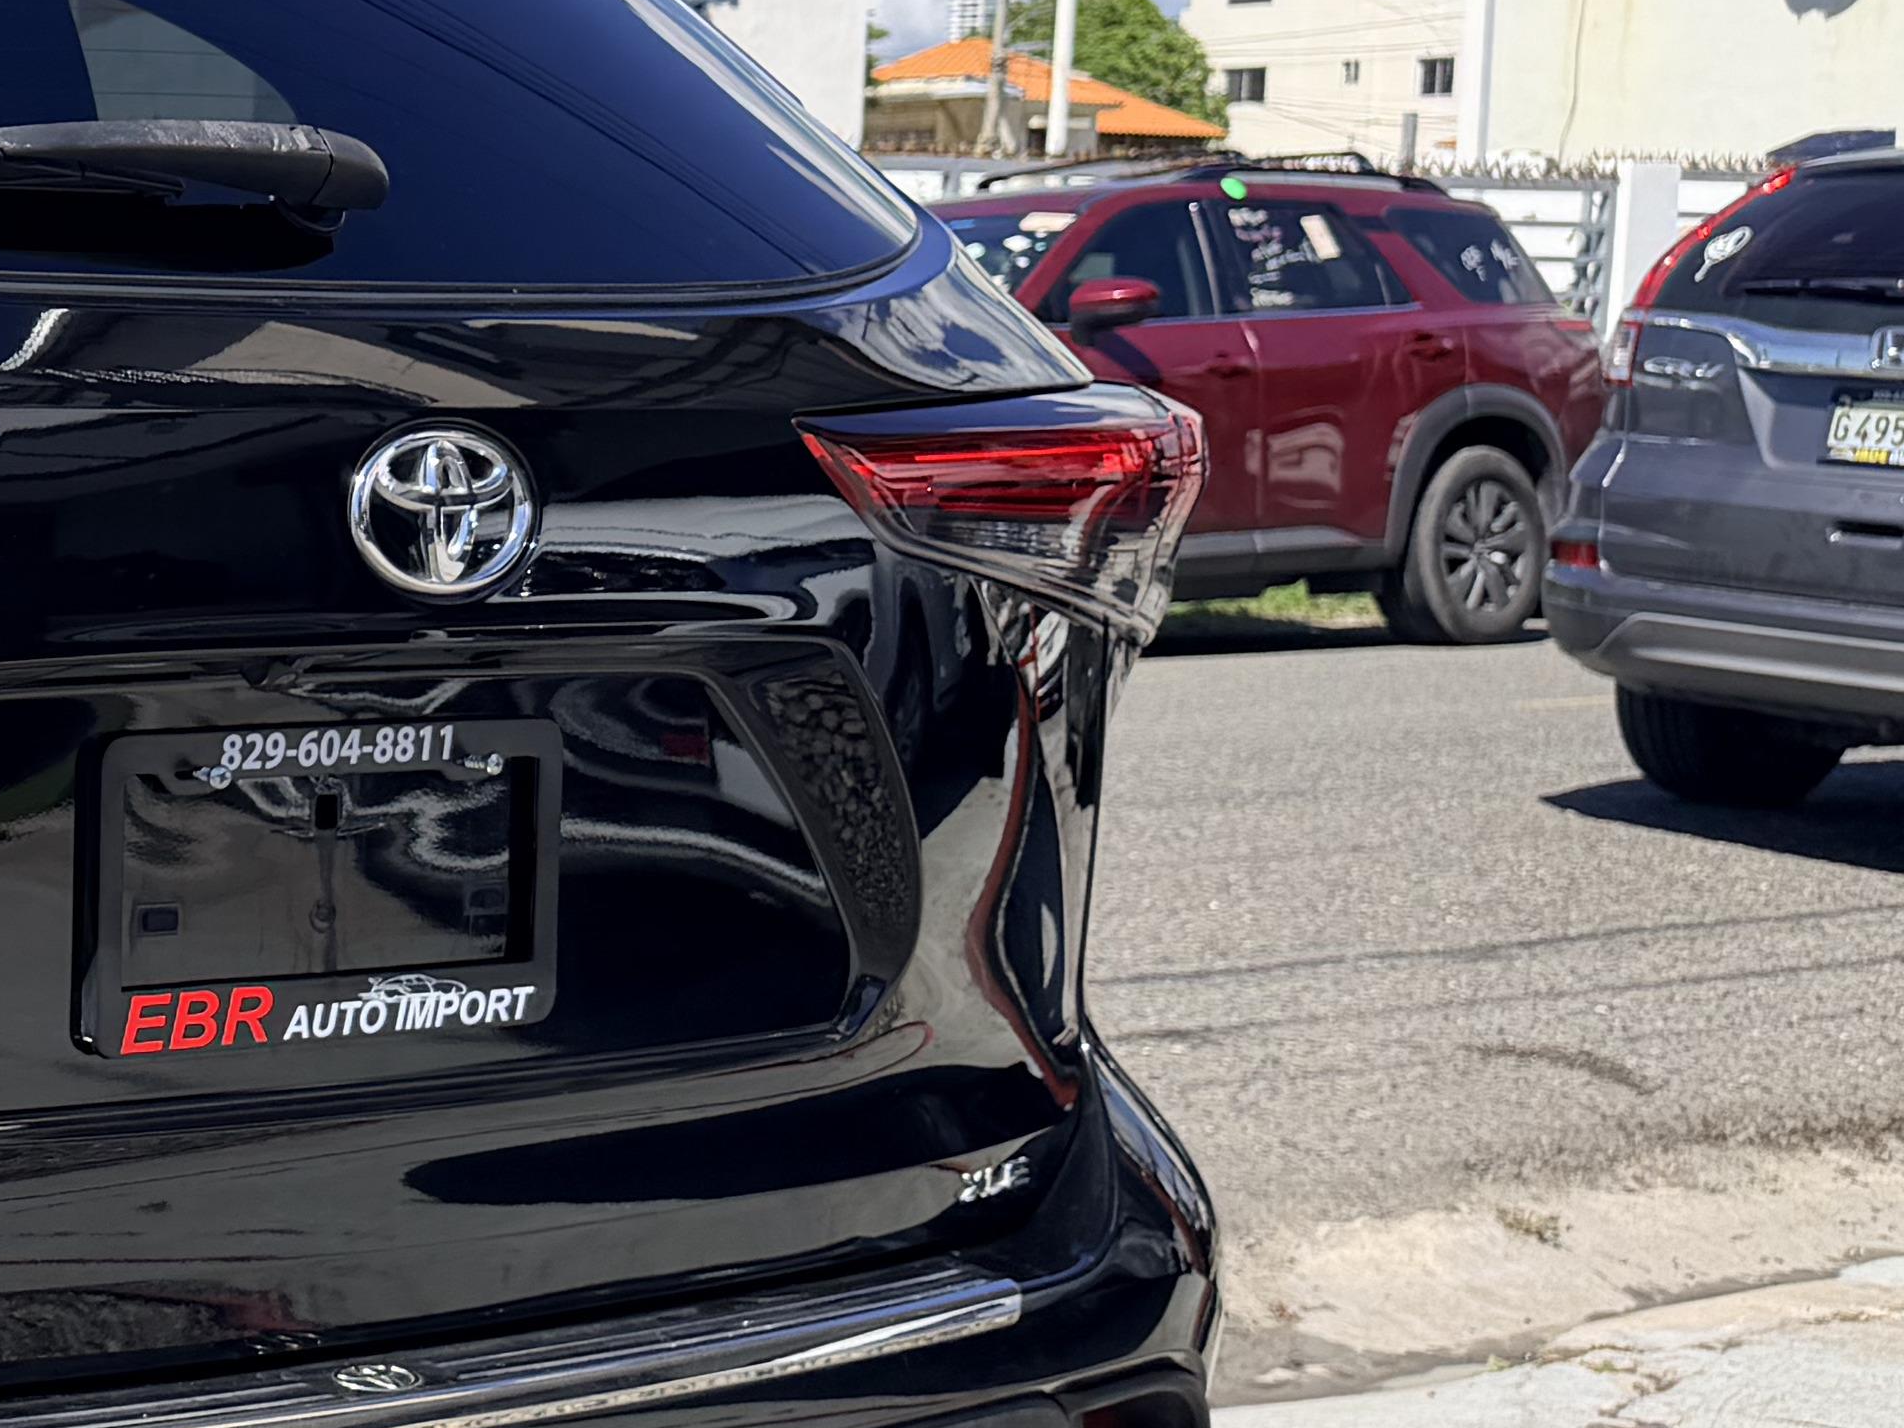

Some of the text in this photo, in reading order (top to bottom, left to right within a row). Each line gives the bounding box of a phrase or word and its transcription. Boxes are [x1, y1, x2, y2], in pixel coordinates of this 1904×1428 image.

[1833, 410, 1904, 447] G495
[220, 724, 455, 771] 829-604-8811
[120, 985, 536, 1056] EBR AUTO IMPORT
[959, 1156, 1031, 1202] XLE
